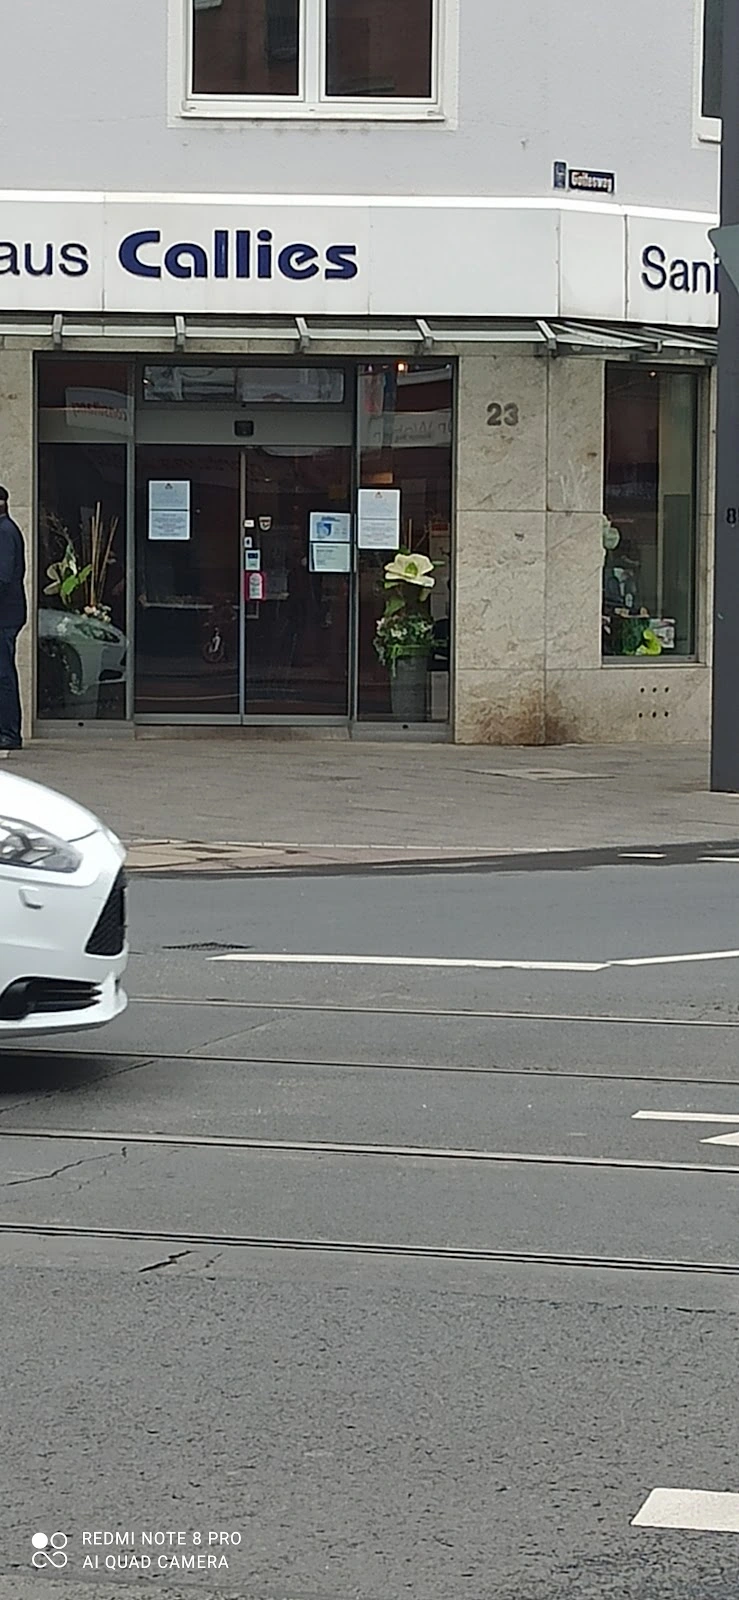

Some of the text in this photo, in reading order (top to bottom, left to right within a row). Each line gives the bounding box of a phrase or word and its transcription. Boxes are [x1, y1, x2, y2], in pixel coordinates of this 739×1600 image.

[0, 229, 358, 280] aus Callies
[487, 402, 519, 426] 23
